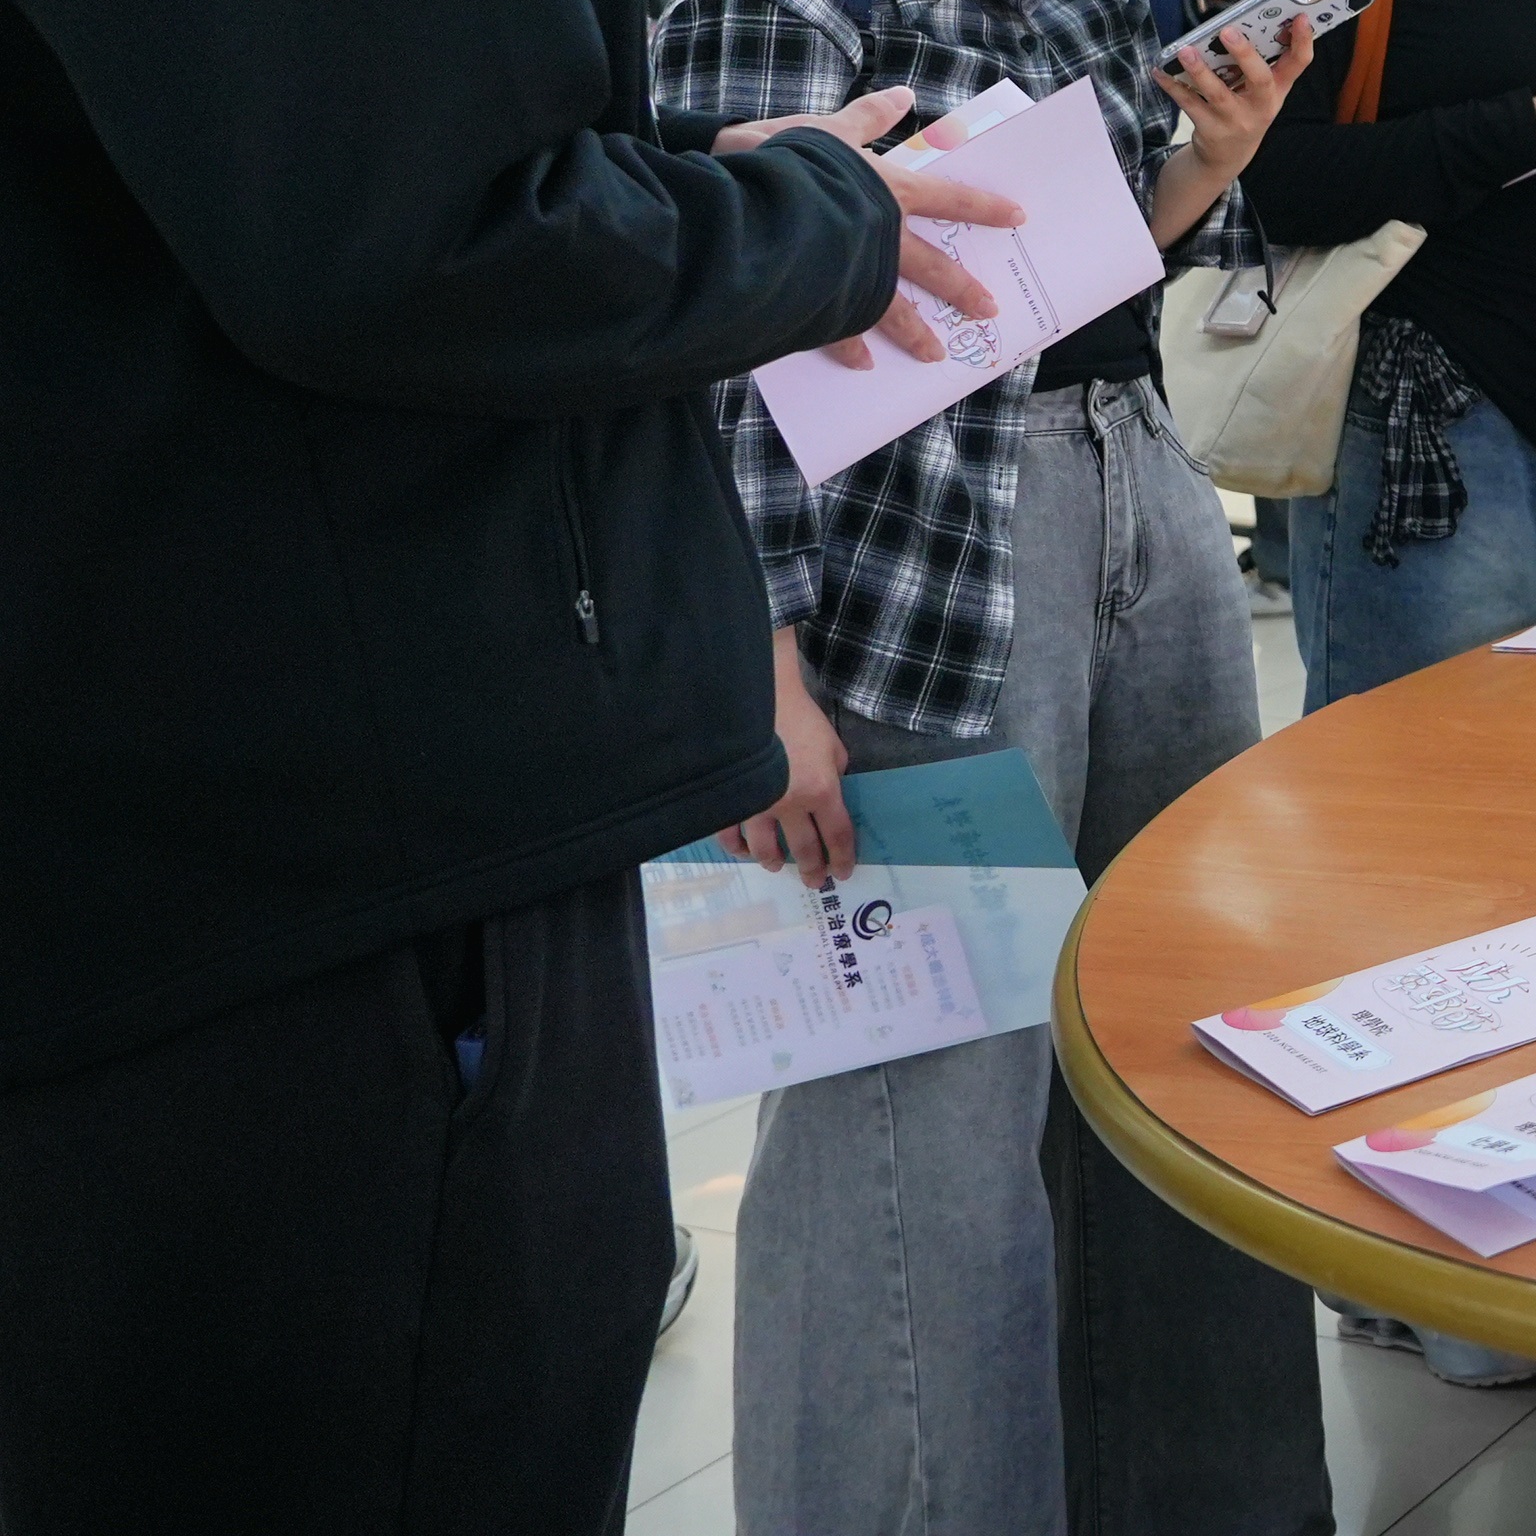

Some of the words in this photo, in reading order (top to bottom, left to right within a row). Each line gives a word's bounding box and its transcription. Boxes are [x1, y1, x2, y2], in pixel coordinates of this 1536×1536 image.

[1007, 257, 1019, 277] 2026
[1017, 277, 1032, 299] NCKU
[1028, 299, 1041, 317] BIKE
[1035, 316, 1048, 332] FEST
[1301, 1014, 1374, 1062] 地球科學系
[1352, 1009, 1394, 1037] 理學院
[1467, 1135, 1523, 1154] 化學系
